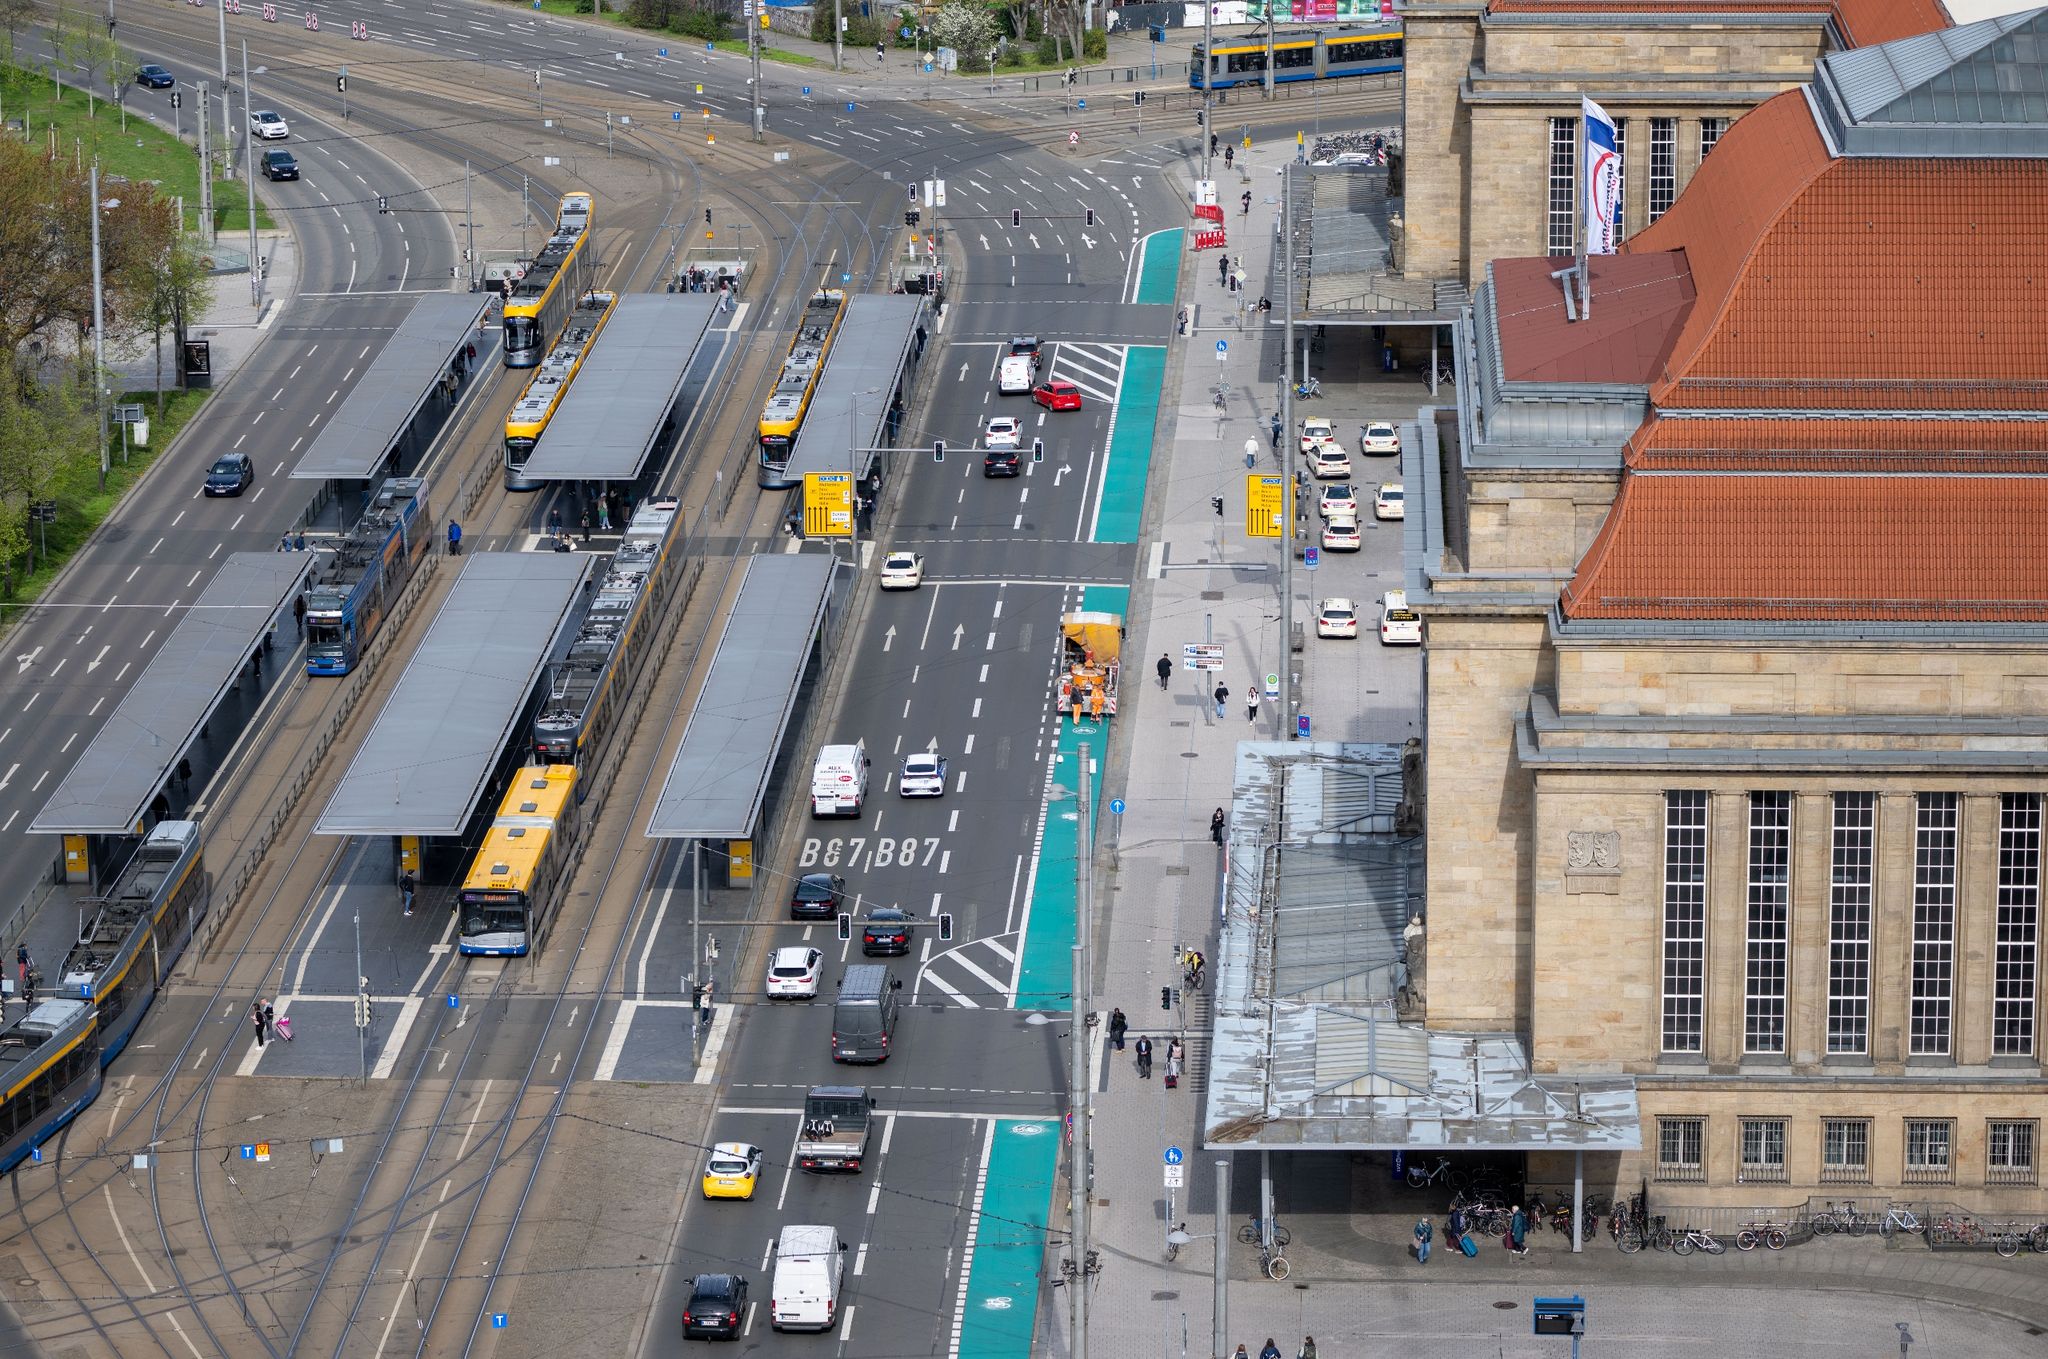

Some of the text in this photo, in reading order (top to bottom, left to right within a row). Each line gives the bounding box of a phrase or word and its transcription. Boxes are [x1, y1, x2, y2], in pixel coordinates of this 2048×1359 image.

[798, 837, 866, 867] B87
[873, 837, 940, 867] B87
[449, 996, 457, 1007] T
[33, 1149, 40, 1160] T
[244, 1146, 252, 1158] T
[495, 1315, 504, 1327] T
